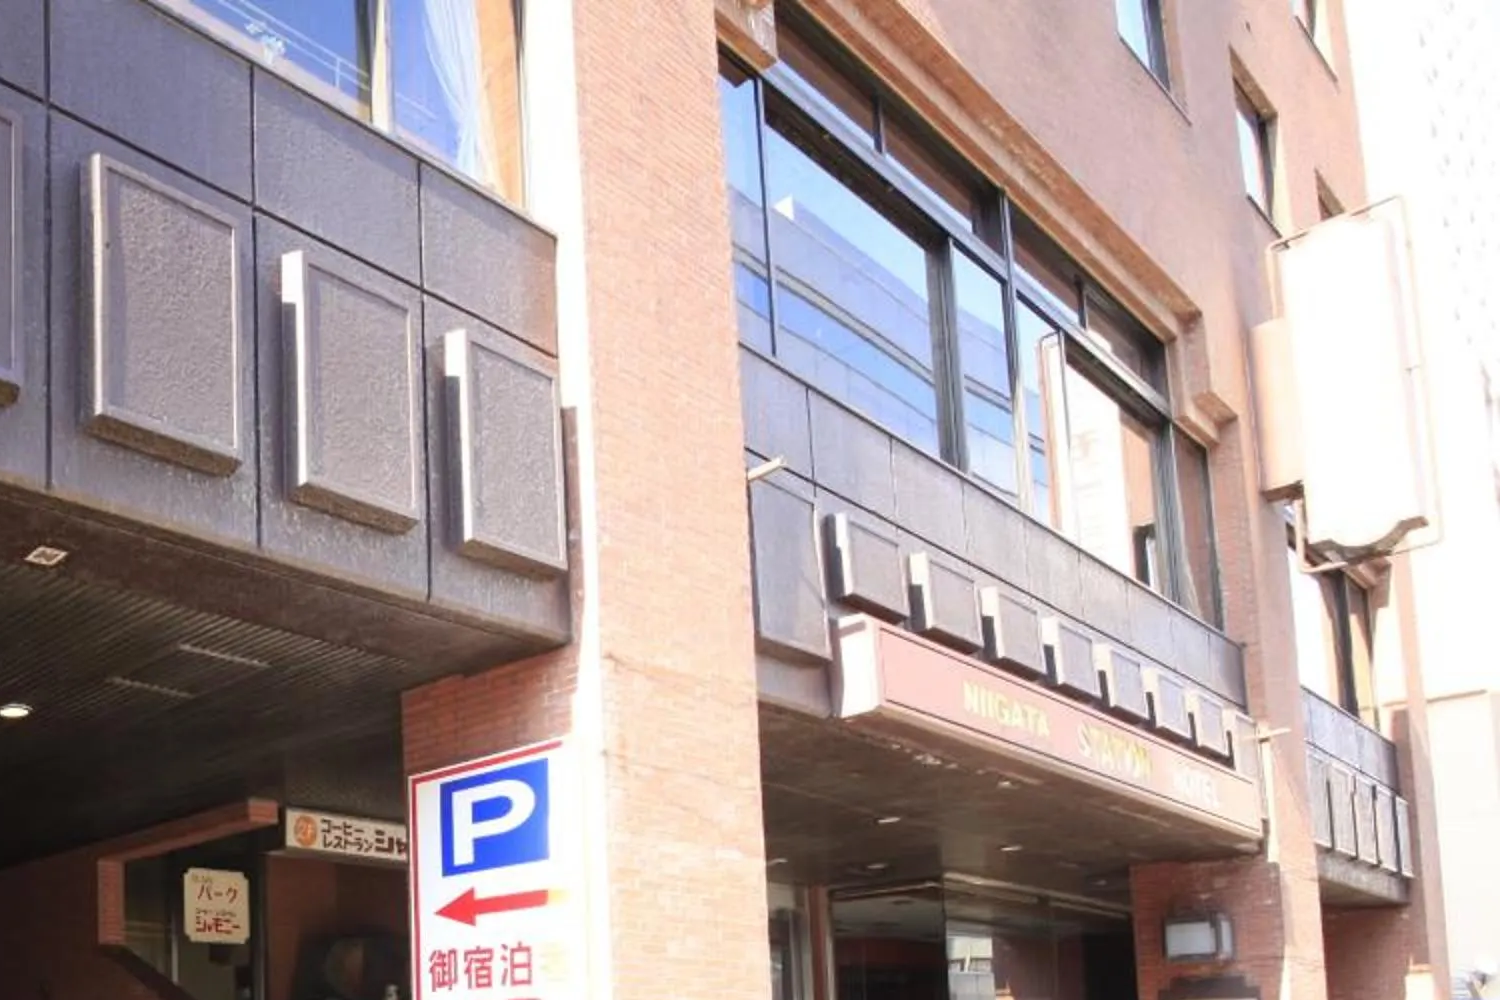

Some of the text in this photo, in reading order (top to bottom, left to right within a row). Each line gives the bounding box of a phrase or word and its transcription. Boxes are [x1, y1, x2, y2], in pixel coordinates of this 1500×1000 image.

[963, 680, 1050, 737] NIIGATA
[320, 818, 364, 836] コーヒー
[452, 779, 536, 867] P
[323, 834, 374, 853] レストラン
